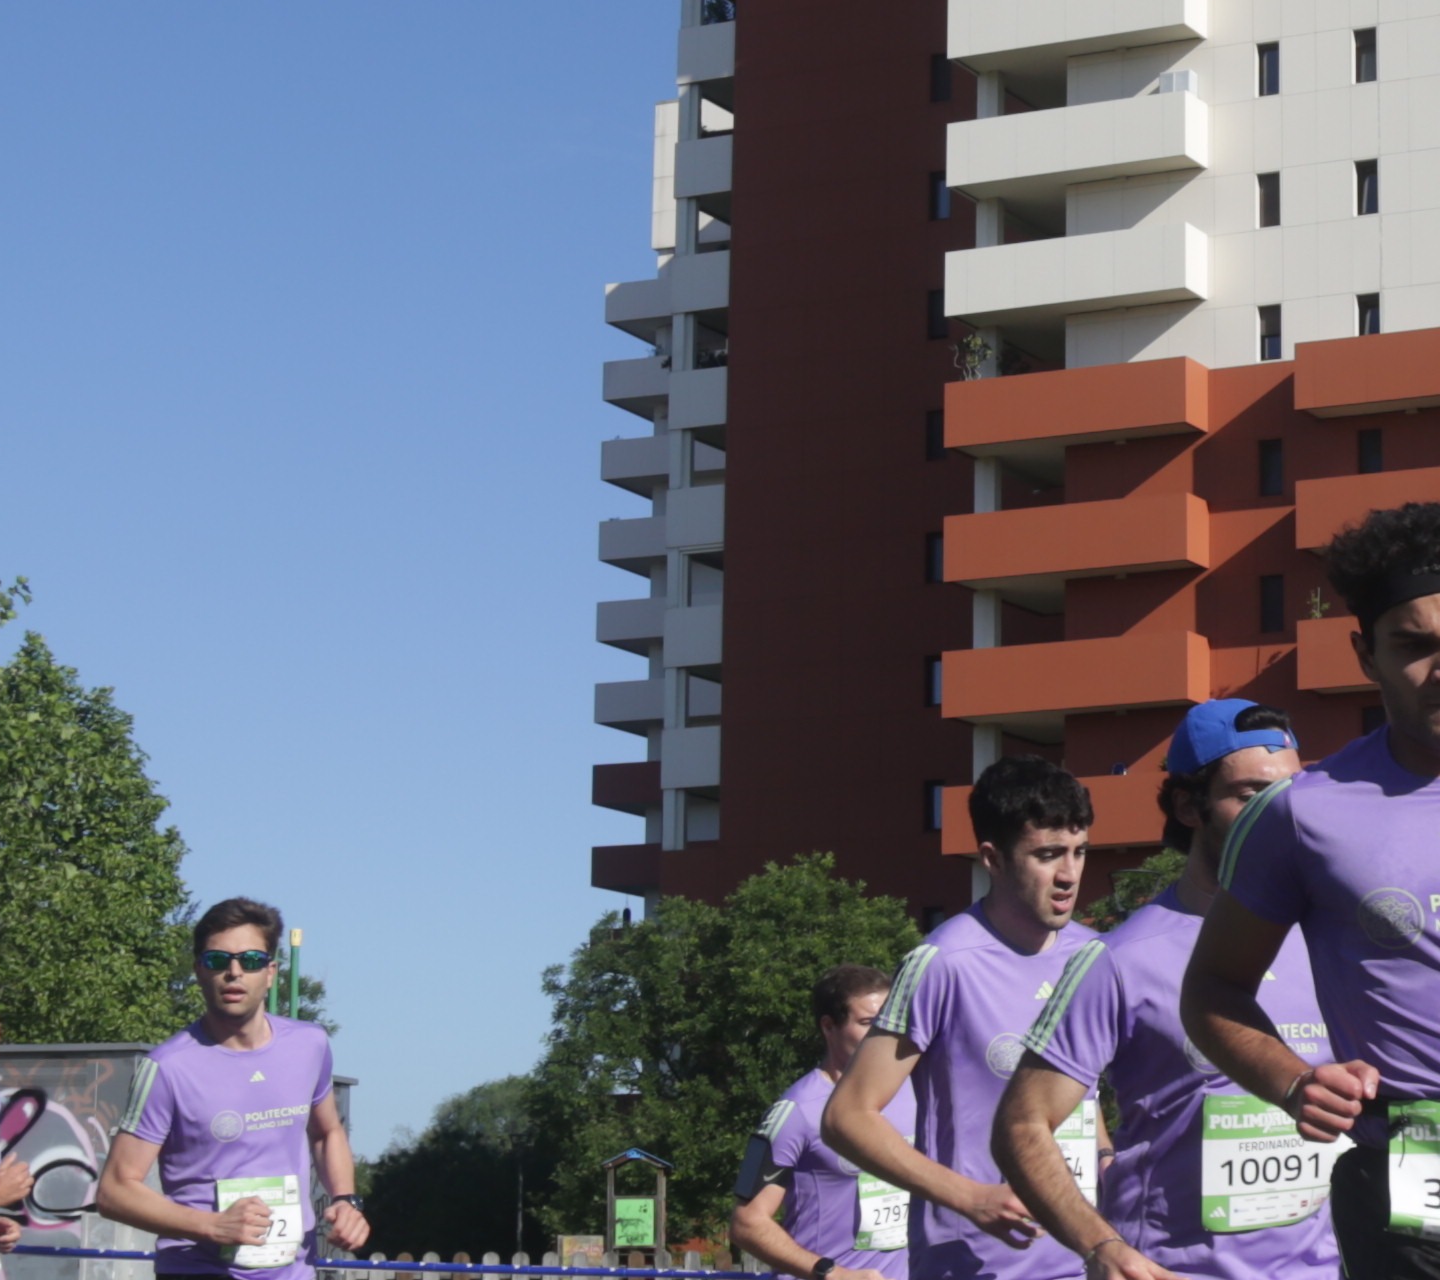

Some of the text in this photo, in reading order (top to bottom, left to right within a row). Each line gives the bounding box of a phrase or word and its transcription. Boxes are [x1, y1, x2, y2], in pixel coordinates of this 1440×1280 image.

[244, 1104, 310, 1123] POLITECNICO
[1238, 1137, 1305, 1152] FERDINANDO
[1220, 1152, 1320, 1187] 10091
[873, 1202, 910, 1226] 2797
